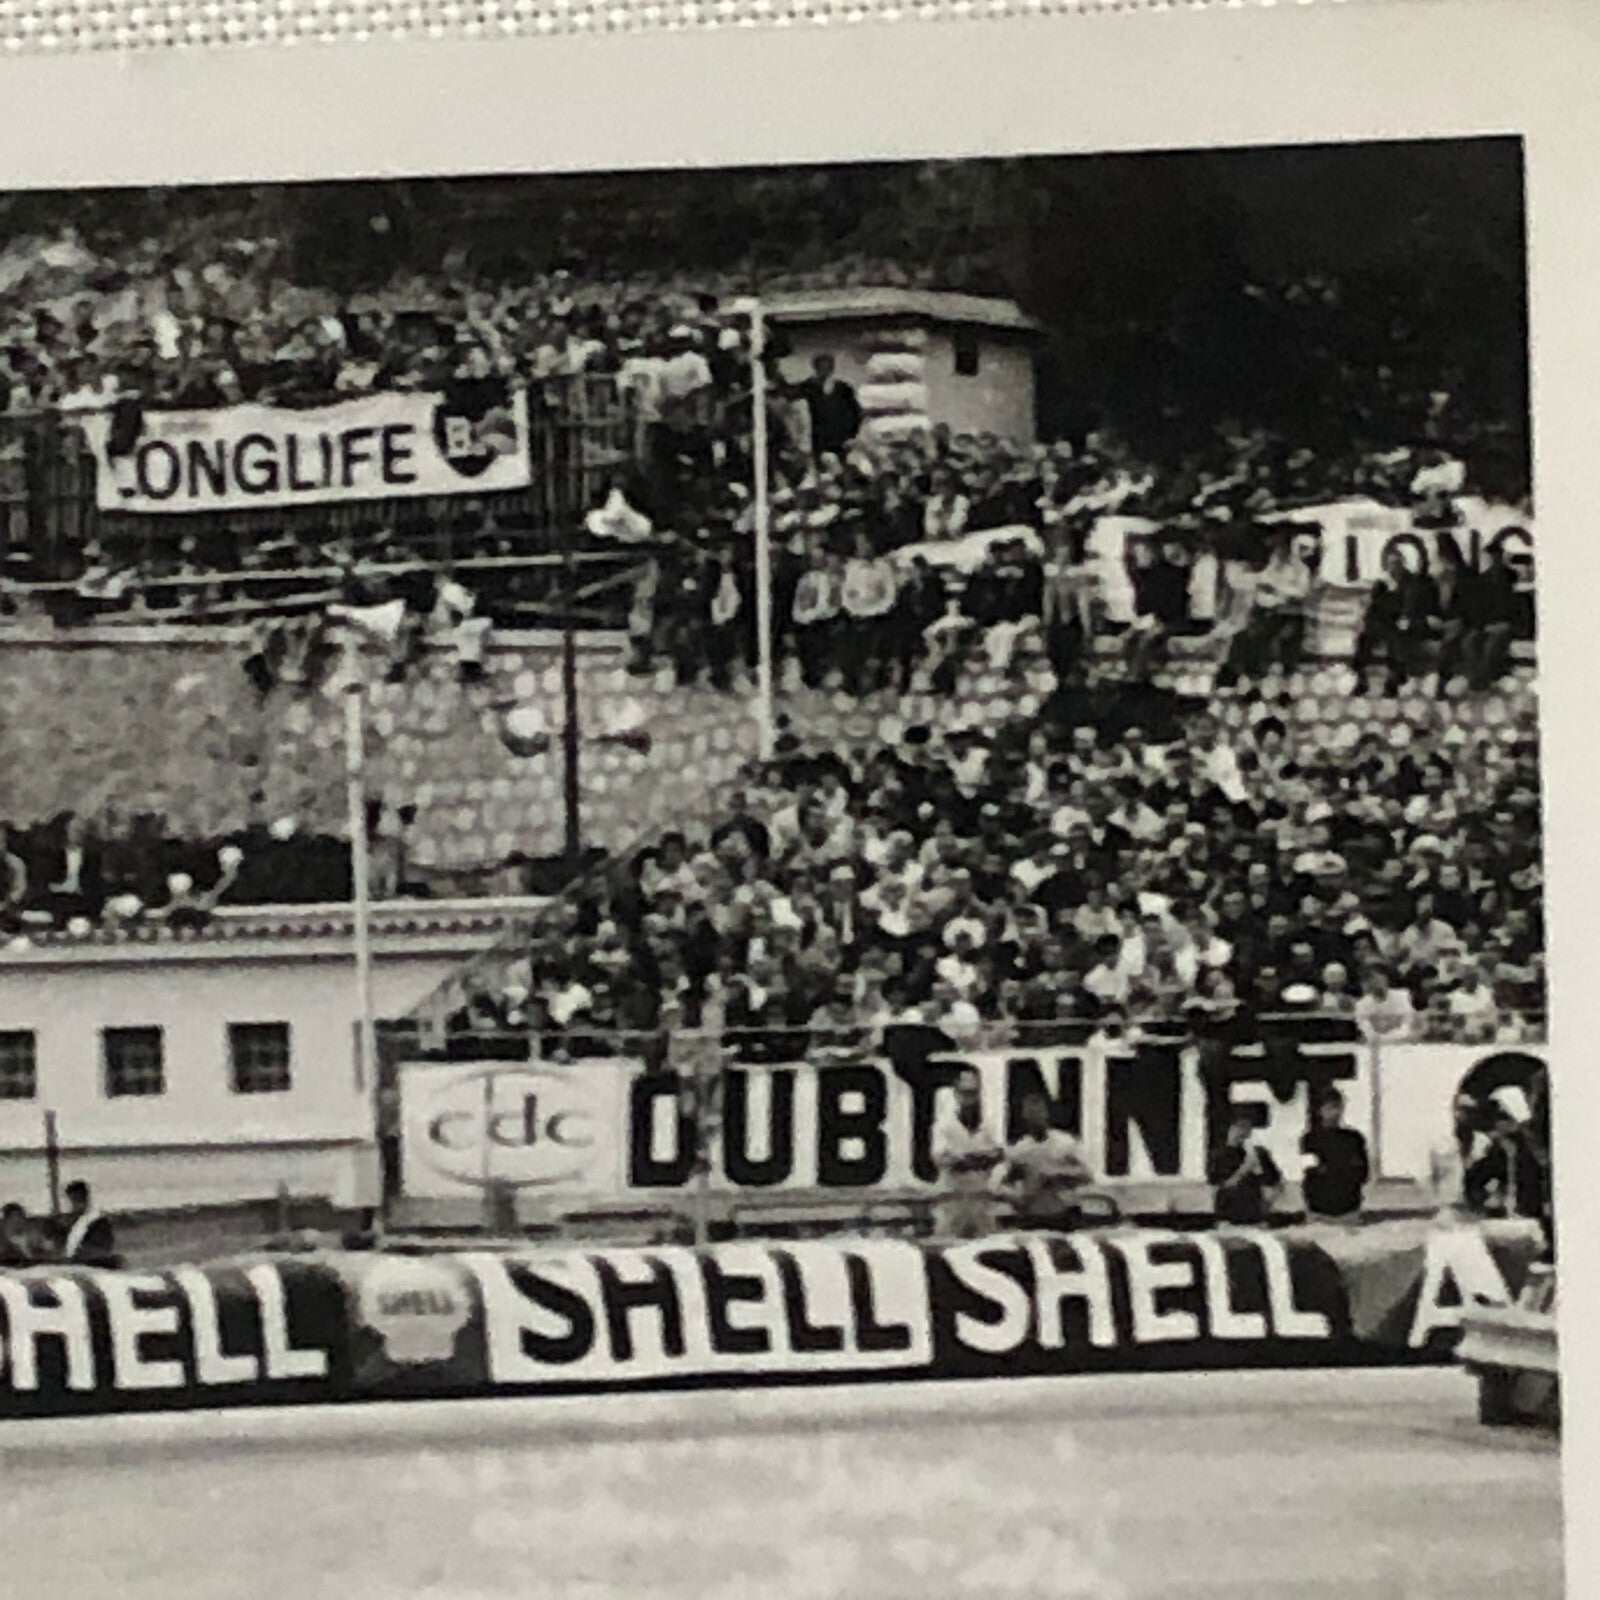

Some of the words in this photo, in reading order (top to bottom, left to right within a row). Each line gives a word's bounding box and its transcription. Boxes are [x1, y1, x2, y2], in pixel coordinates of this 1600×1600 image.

[428, 1092, 595, 1149] cdc
[0, 1264, 327, 1391] HELL
[504, 1246, 912, 1365] SHELL
[943, 1230, 1333, 1354] SHELL
